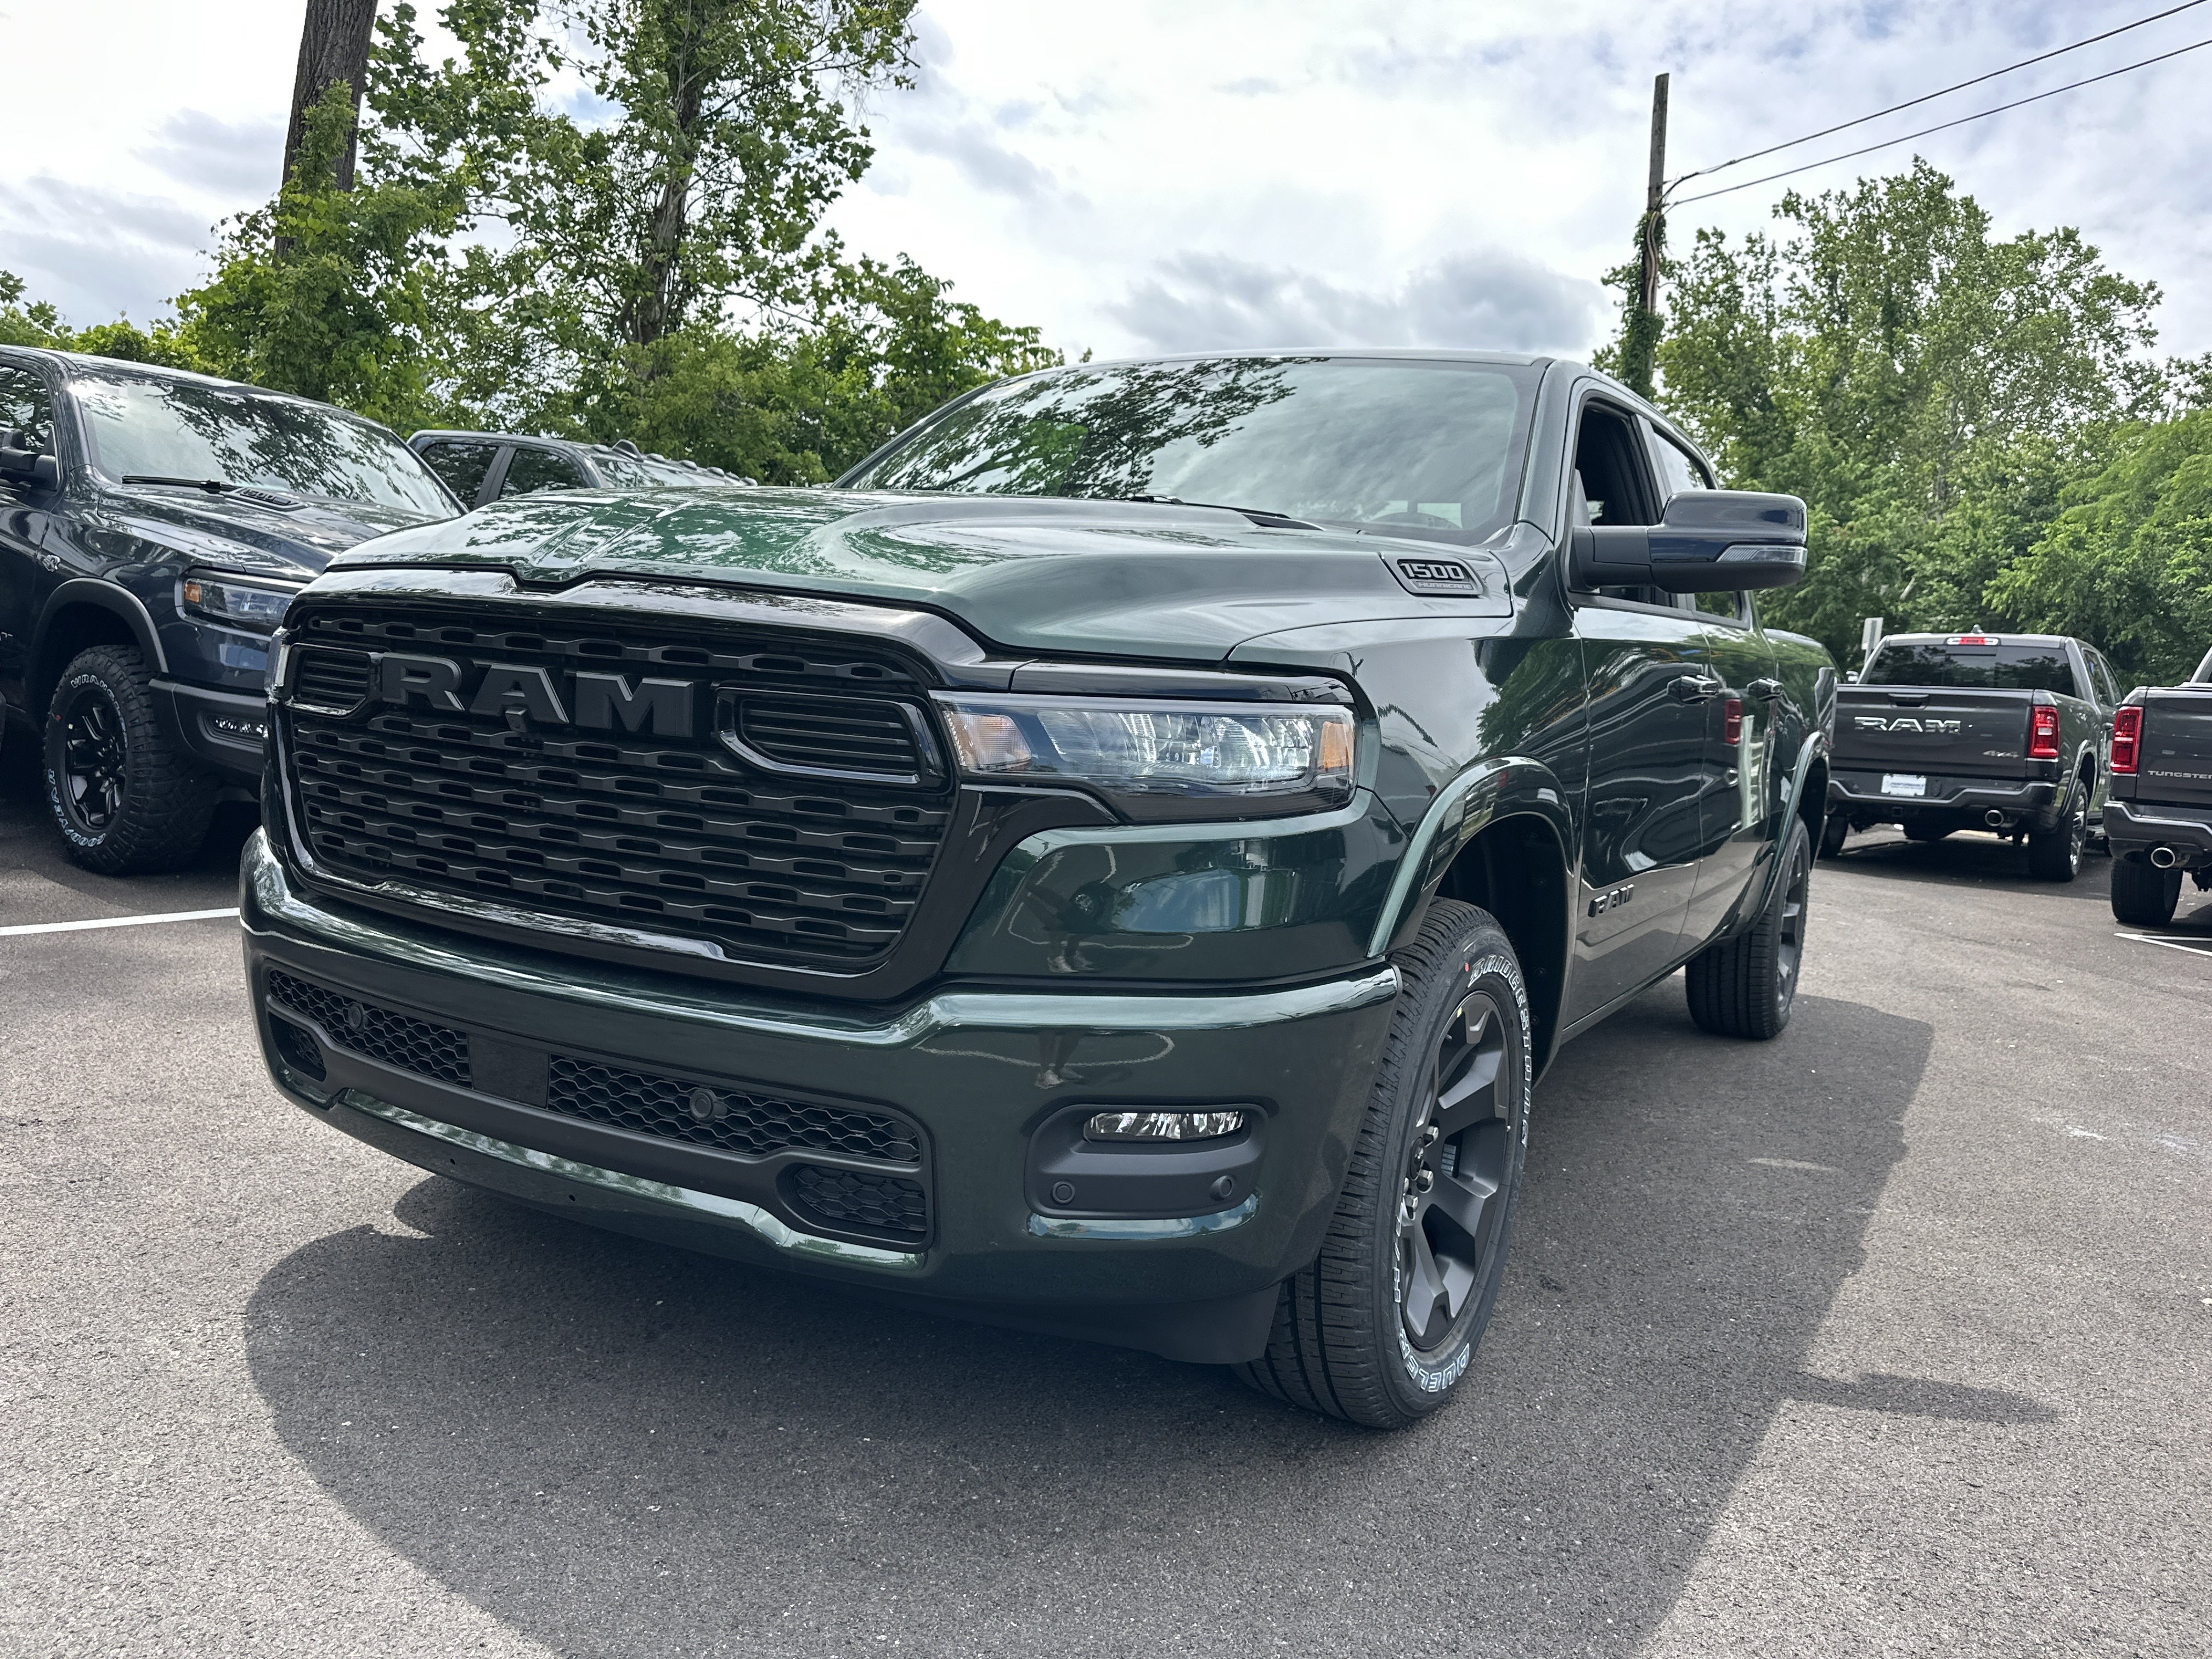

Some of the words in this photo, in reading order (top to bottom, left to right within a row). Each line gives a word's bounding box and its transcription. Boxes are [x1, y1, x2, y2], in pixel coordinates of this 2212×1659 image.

[1399, 562, 1464, 580] 1500
[382, 651, 694, 737] RAM
[1854, 716, 1961, 734] RAM
[48, 768, 106, 847] GOODYEAR
[1587, 884, 1634, 918] RAM
[1468, 954, 1532, 1149] BRIDGESTONE
[1398, 1328, 1470, 1392] DUELER
